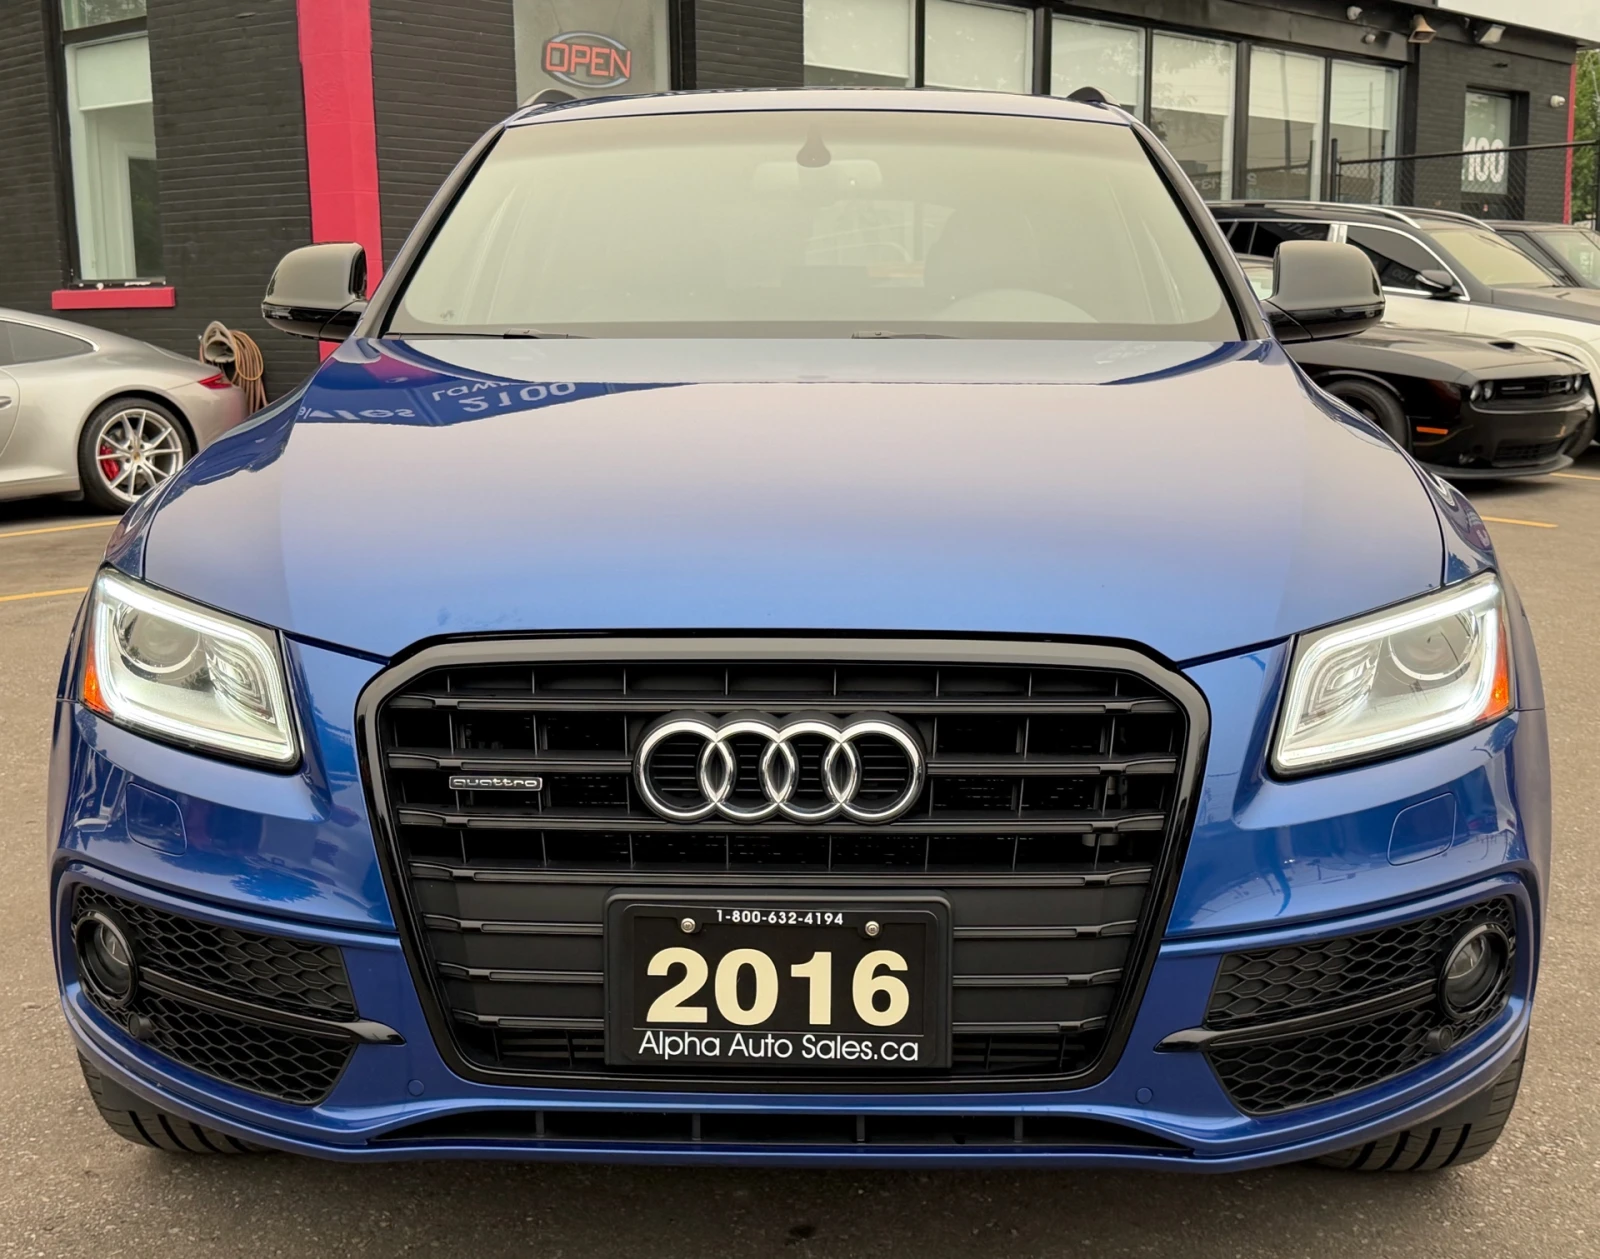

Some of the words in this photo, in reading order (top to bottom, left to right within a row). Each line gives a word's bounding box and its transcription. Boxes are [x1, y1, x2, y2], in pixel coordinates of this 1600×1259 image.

[545, 42, 631, 78] OPEN
[1463, 136, 1505, 183] 100
[453, 778, 538, 787] quattro
[716, 909, 844, 926] 1-800-632-4194
[646, 946, 910, 1027] 2016
[638, 1030, 721, 1060] Alpha
[728, 1032, 794, 1059] Auto
[801, 1034, 919, 1061] Sales.ca
